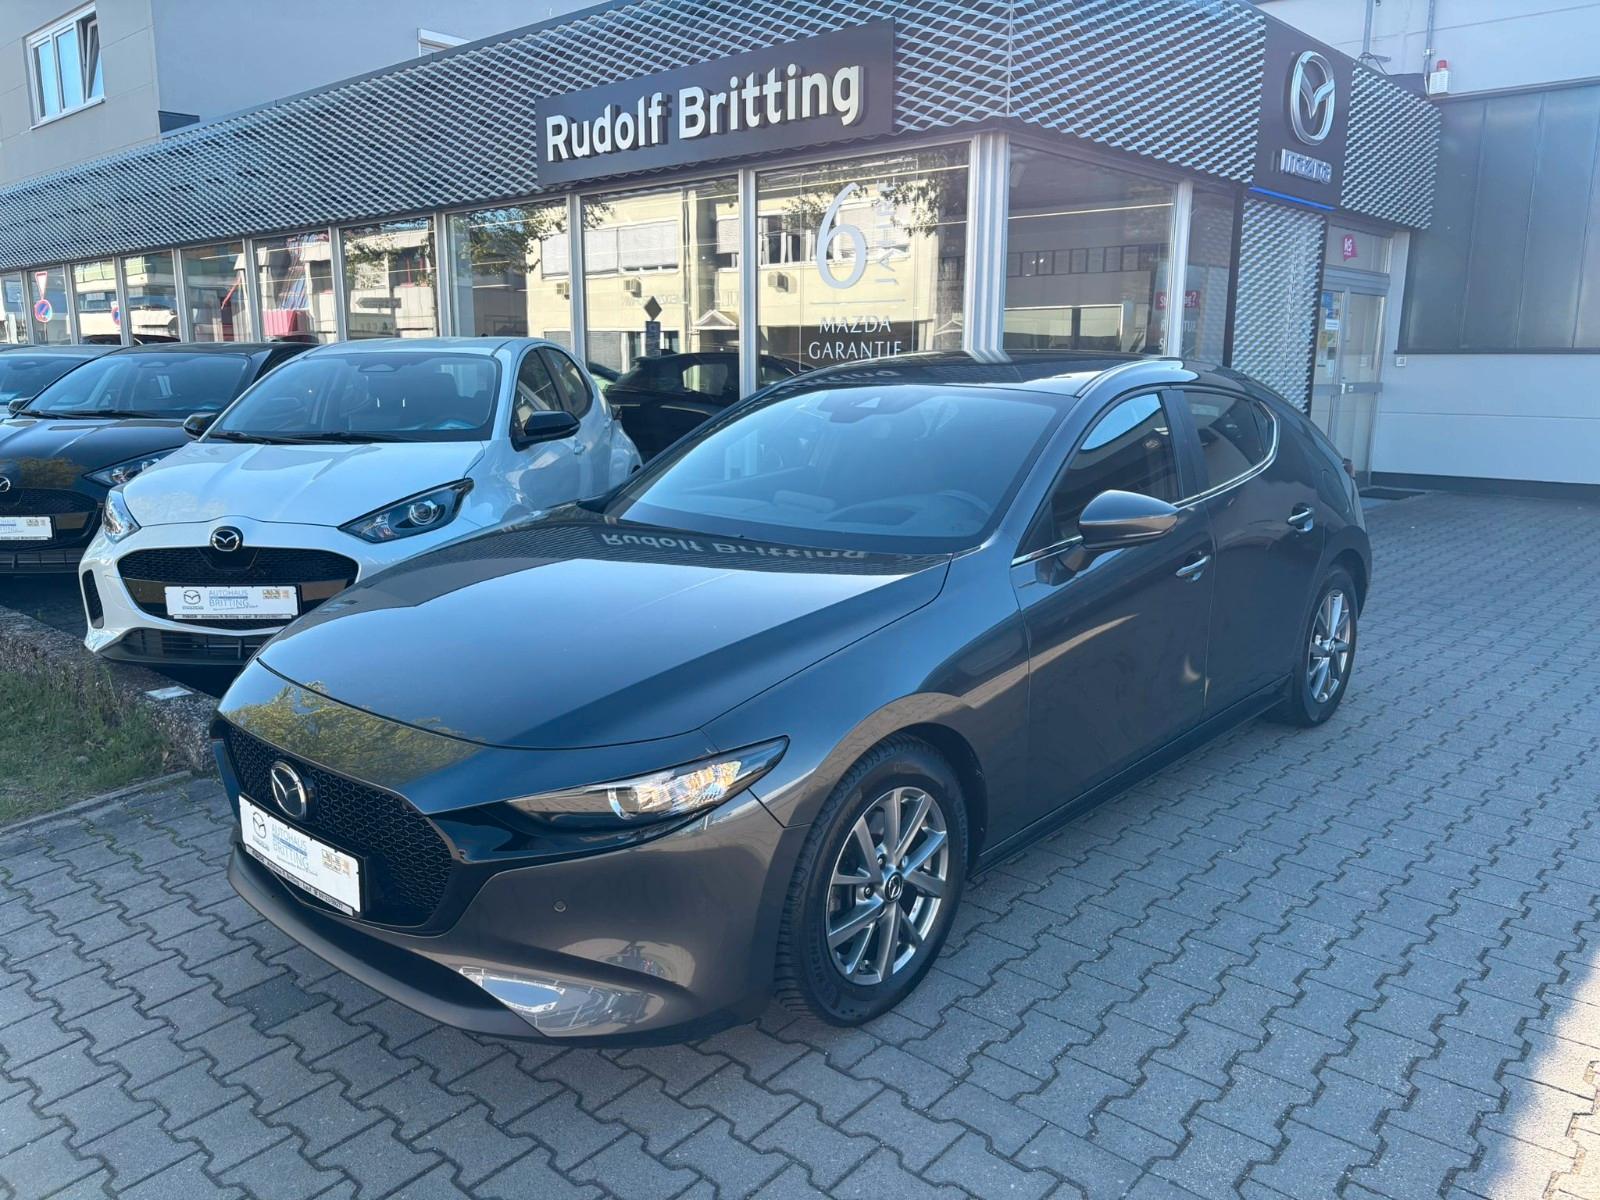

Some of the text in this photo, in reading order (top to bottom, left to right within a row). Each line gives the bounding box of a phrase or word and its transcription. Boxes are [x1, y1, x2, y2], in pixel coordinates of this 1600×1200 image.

[546, 63, 862, 162] Rudolf Britting
[816, 181, 868, 289] 6
[819, 315, 892, 334] MAZDA
[808, 341, 902, 360] GARANTIE
[208, 598, 250, 608] BRITTING
